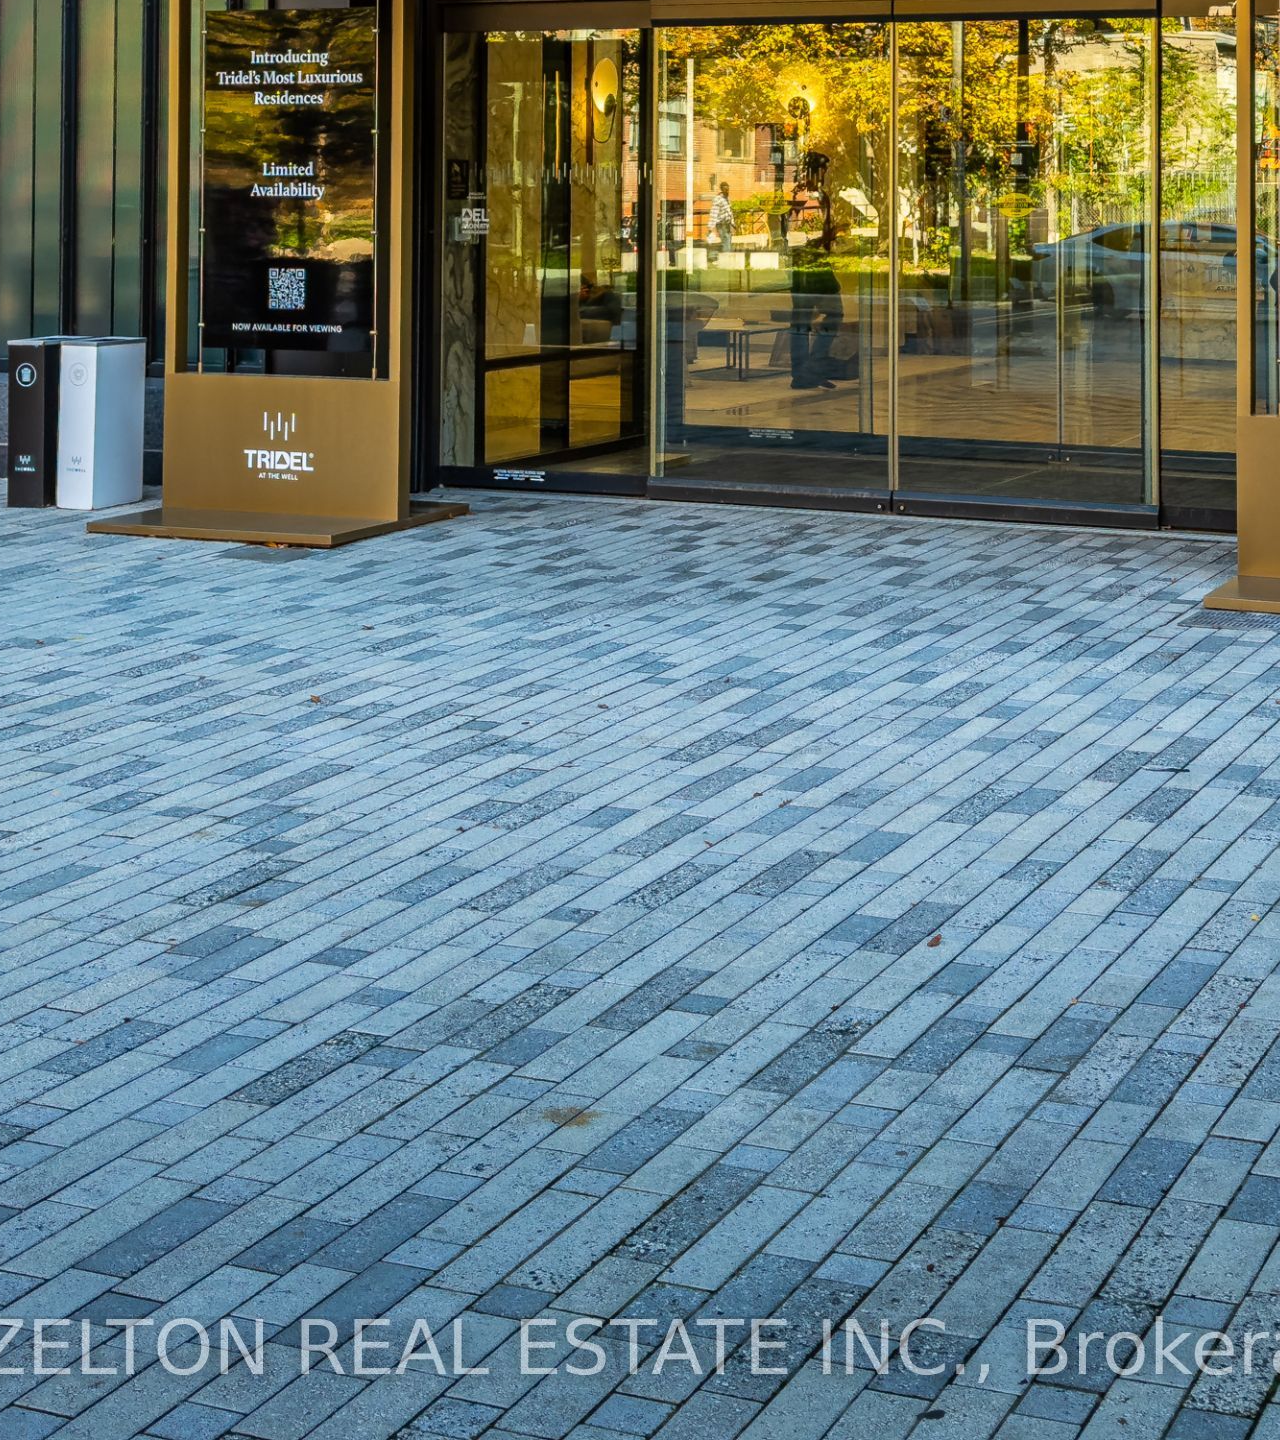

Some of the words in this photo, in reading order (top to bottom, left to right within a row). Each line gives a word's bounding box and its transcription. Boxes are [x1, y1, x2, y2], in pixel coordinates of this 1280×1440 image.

[250, 48, 329, 67] Introducing
[215, 69, 261, 85] Tridel's
[262, 70, 295, 85] Most
[297, 69, 364, 85] Luxurious
[253, 90, 324, 105] Residences
[262, 160, 315, 177] Limited
[250, 182, 326, 201] Availability
[232, 322, 251, 331] NOW
[252, 323, 291, 332] AVAILABLE
[292, 324, 308, 332] FOR
[309, 324, 343, 333] VIEWING
[268, 472, 280, 480] THE
[281, 473, 299, 481] WELL
